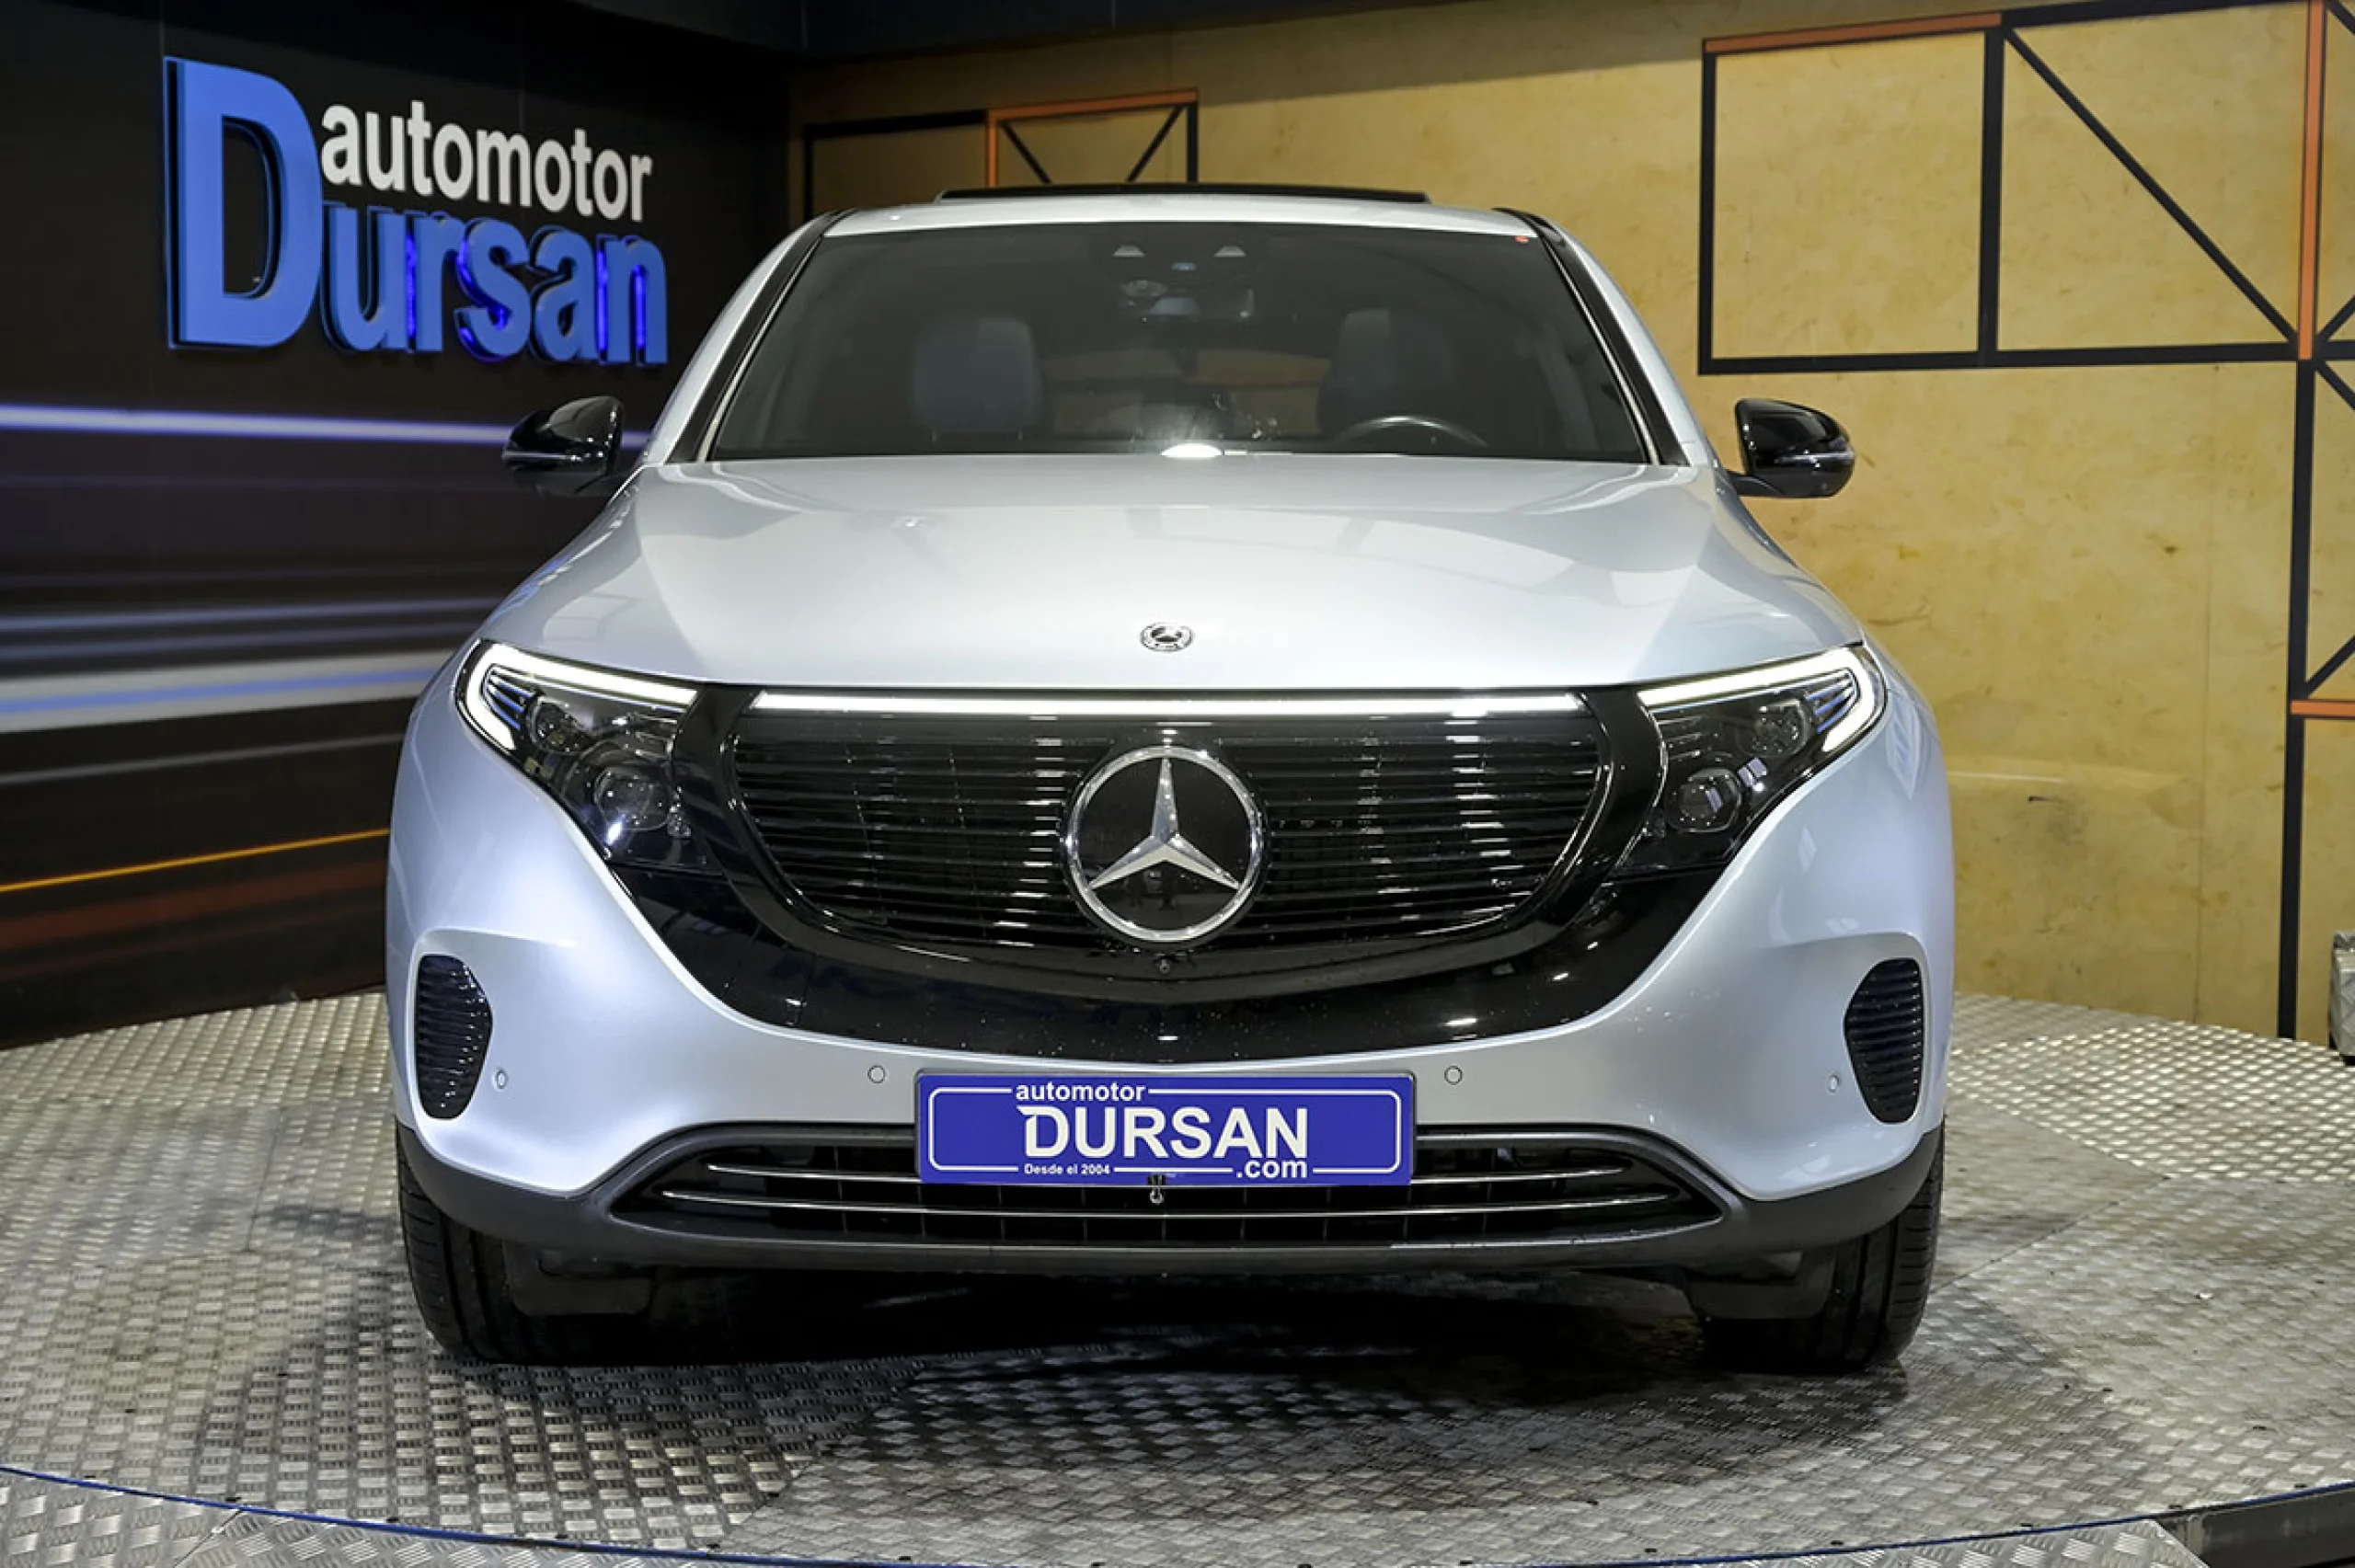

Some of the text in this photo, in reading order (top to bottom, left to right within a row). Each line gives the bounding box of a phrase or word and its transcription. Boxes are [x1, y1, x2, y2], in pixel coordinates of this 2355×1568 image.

[321, 100, 652, 222] automotor
[163, 55, 668, 365] Dursan
[1016, 1082, 1145, 1102] automotor
[1016, 1105, 1308, 1159] DURSAN
[1024, 1163, 1110, 1175] Desde el 2004
[1235, 1161, 1308, 1179] .com
